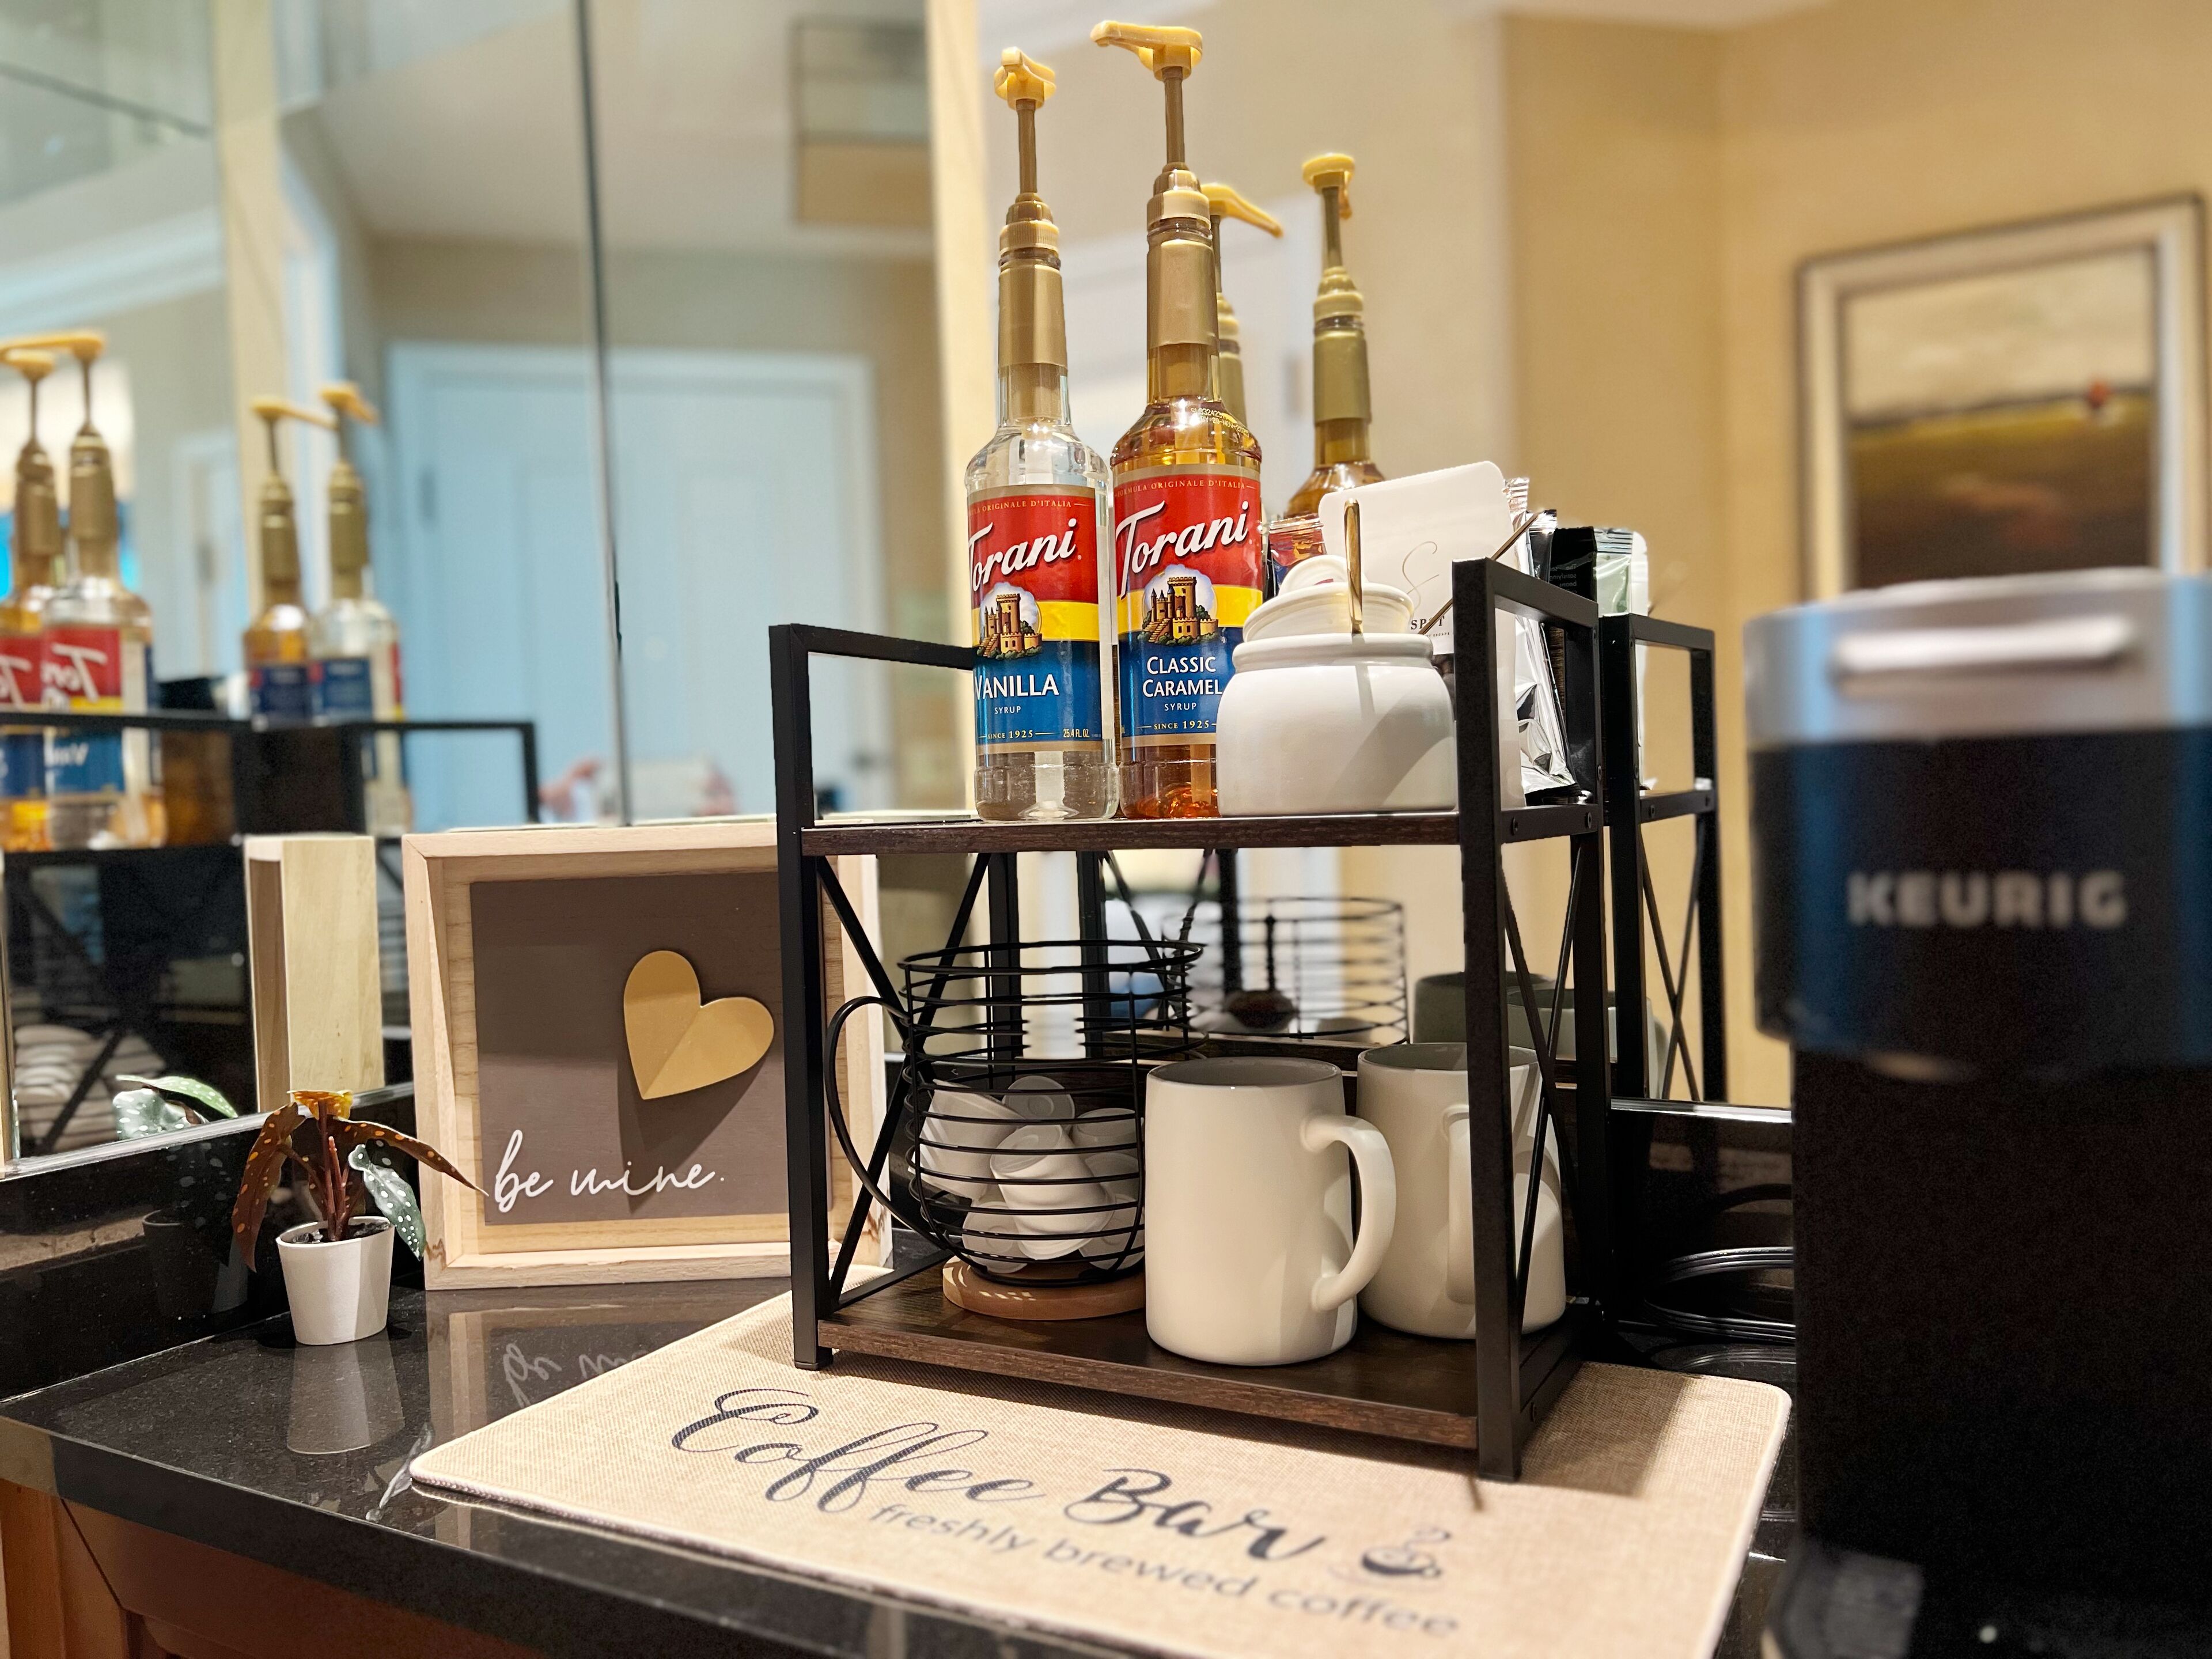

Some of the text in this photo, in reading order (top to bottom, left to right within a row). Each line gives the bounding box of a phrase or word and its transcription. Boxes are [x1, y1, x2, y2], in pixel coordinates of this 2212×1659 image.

[1151, 480, 1203, 490] ORIGINALE
[1209, 480, 1245, 489] D'ITALIA
[982, 501, 1027, 512] ORIGINALE
[1031, 499, 1071, 507] D'ITALIA
[1115, 500, 1249, 600] Torani
[1147, 656, 1217, 675] CLASSIC
[975, 674, 1059, 700] VANILLA
[1142, 679, 1223, 698] CARAMEL
[994, 706, 1021, 715] SYRUP
[1164, 702, 1197, 711] SYRUP
[1009, 729, 1033, 739] 1925
[1063, 728, 1074, 738] 25.4
[1075, 729, 1082, 738] FL
[1083, 728, 1090, 738] OZ
[1154, 719, 1210, 730] SINCE 1925
[1847, 870, 2128, 929] KEURIG
[494, 1129, 554, 1213] be
[671, 1388, 1328, 1561] Coffee Bar
[869, 1503, 1459, 1636] freshly brewed coffee
